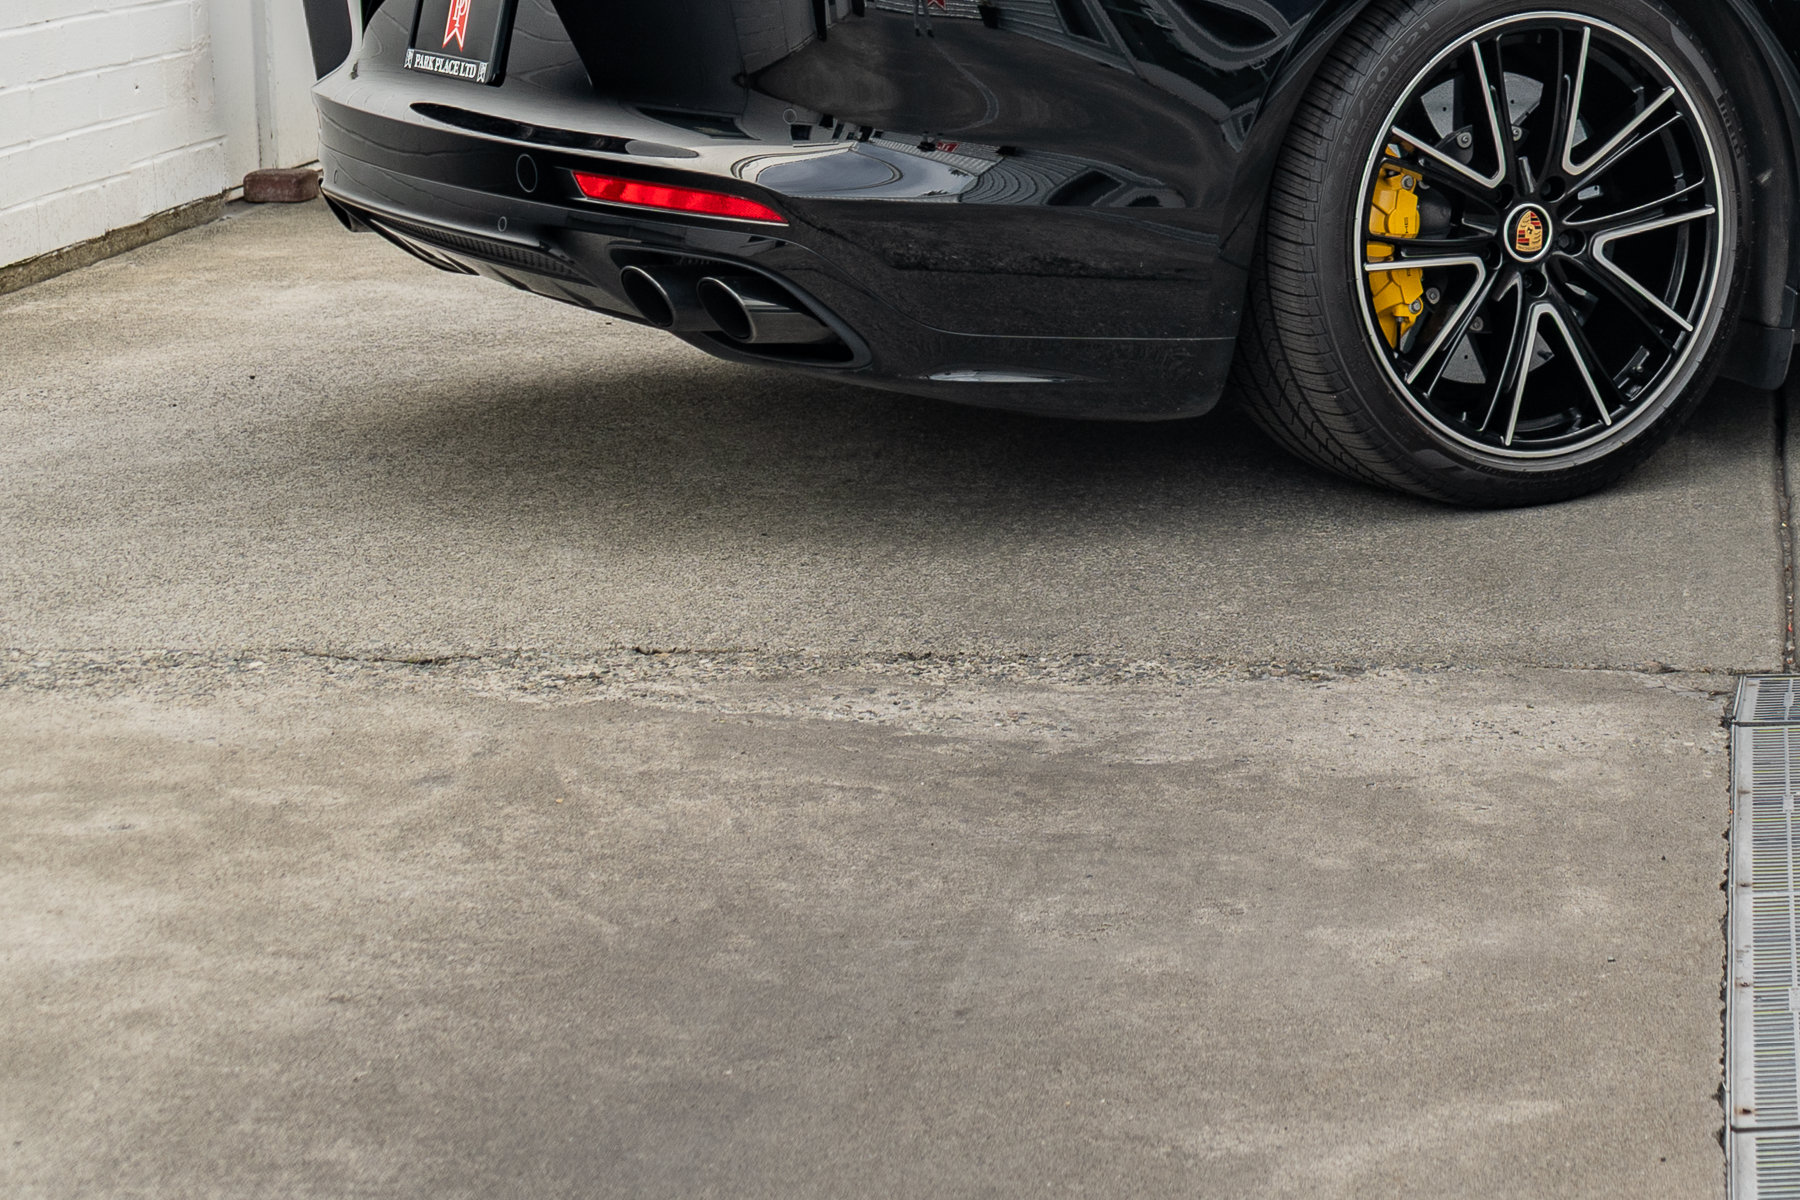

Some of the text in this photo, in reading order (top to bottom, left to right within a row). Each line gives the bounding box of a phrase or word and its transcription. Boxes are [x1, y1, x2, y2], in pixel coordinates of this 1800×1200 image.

[1391, 21, 1431, 63] R21
[414, 53, 477, 78] PARK PLACE LTD
